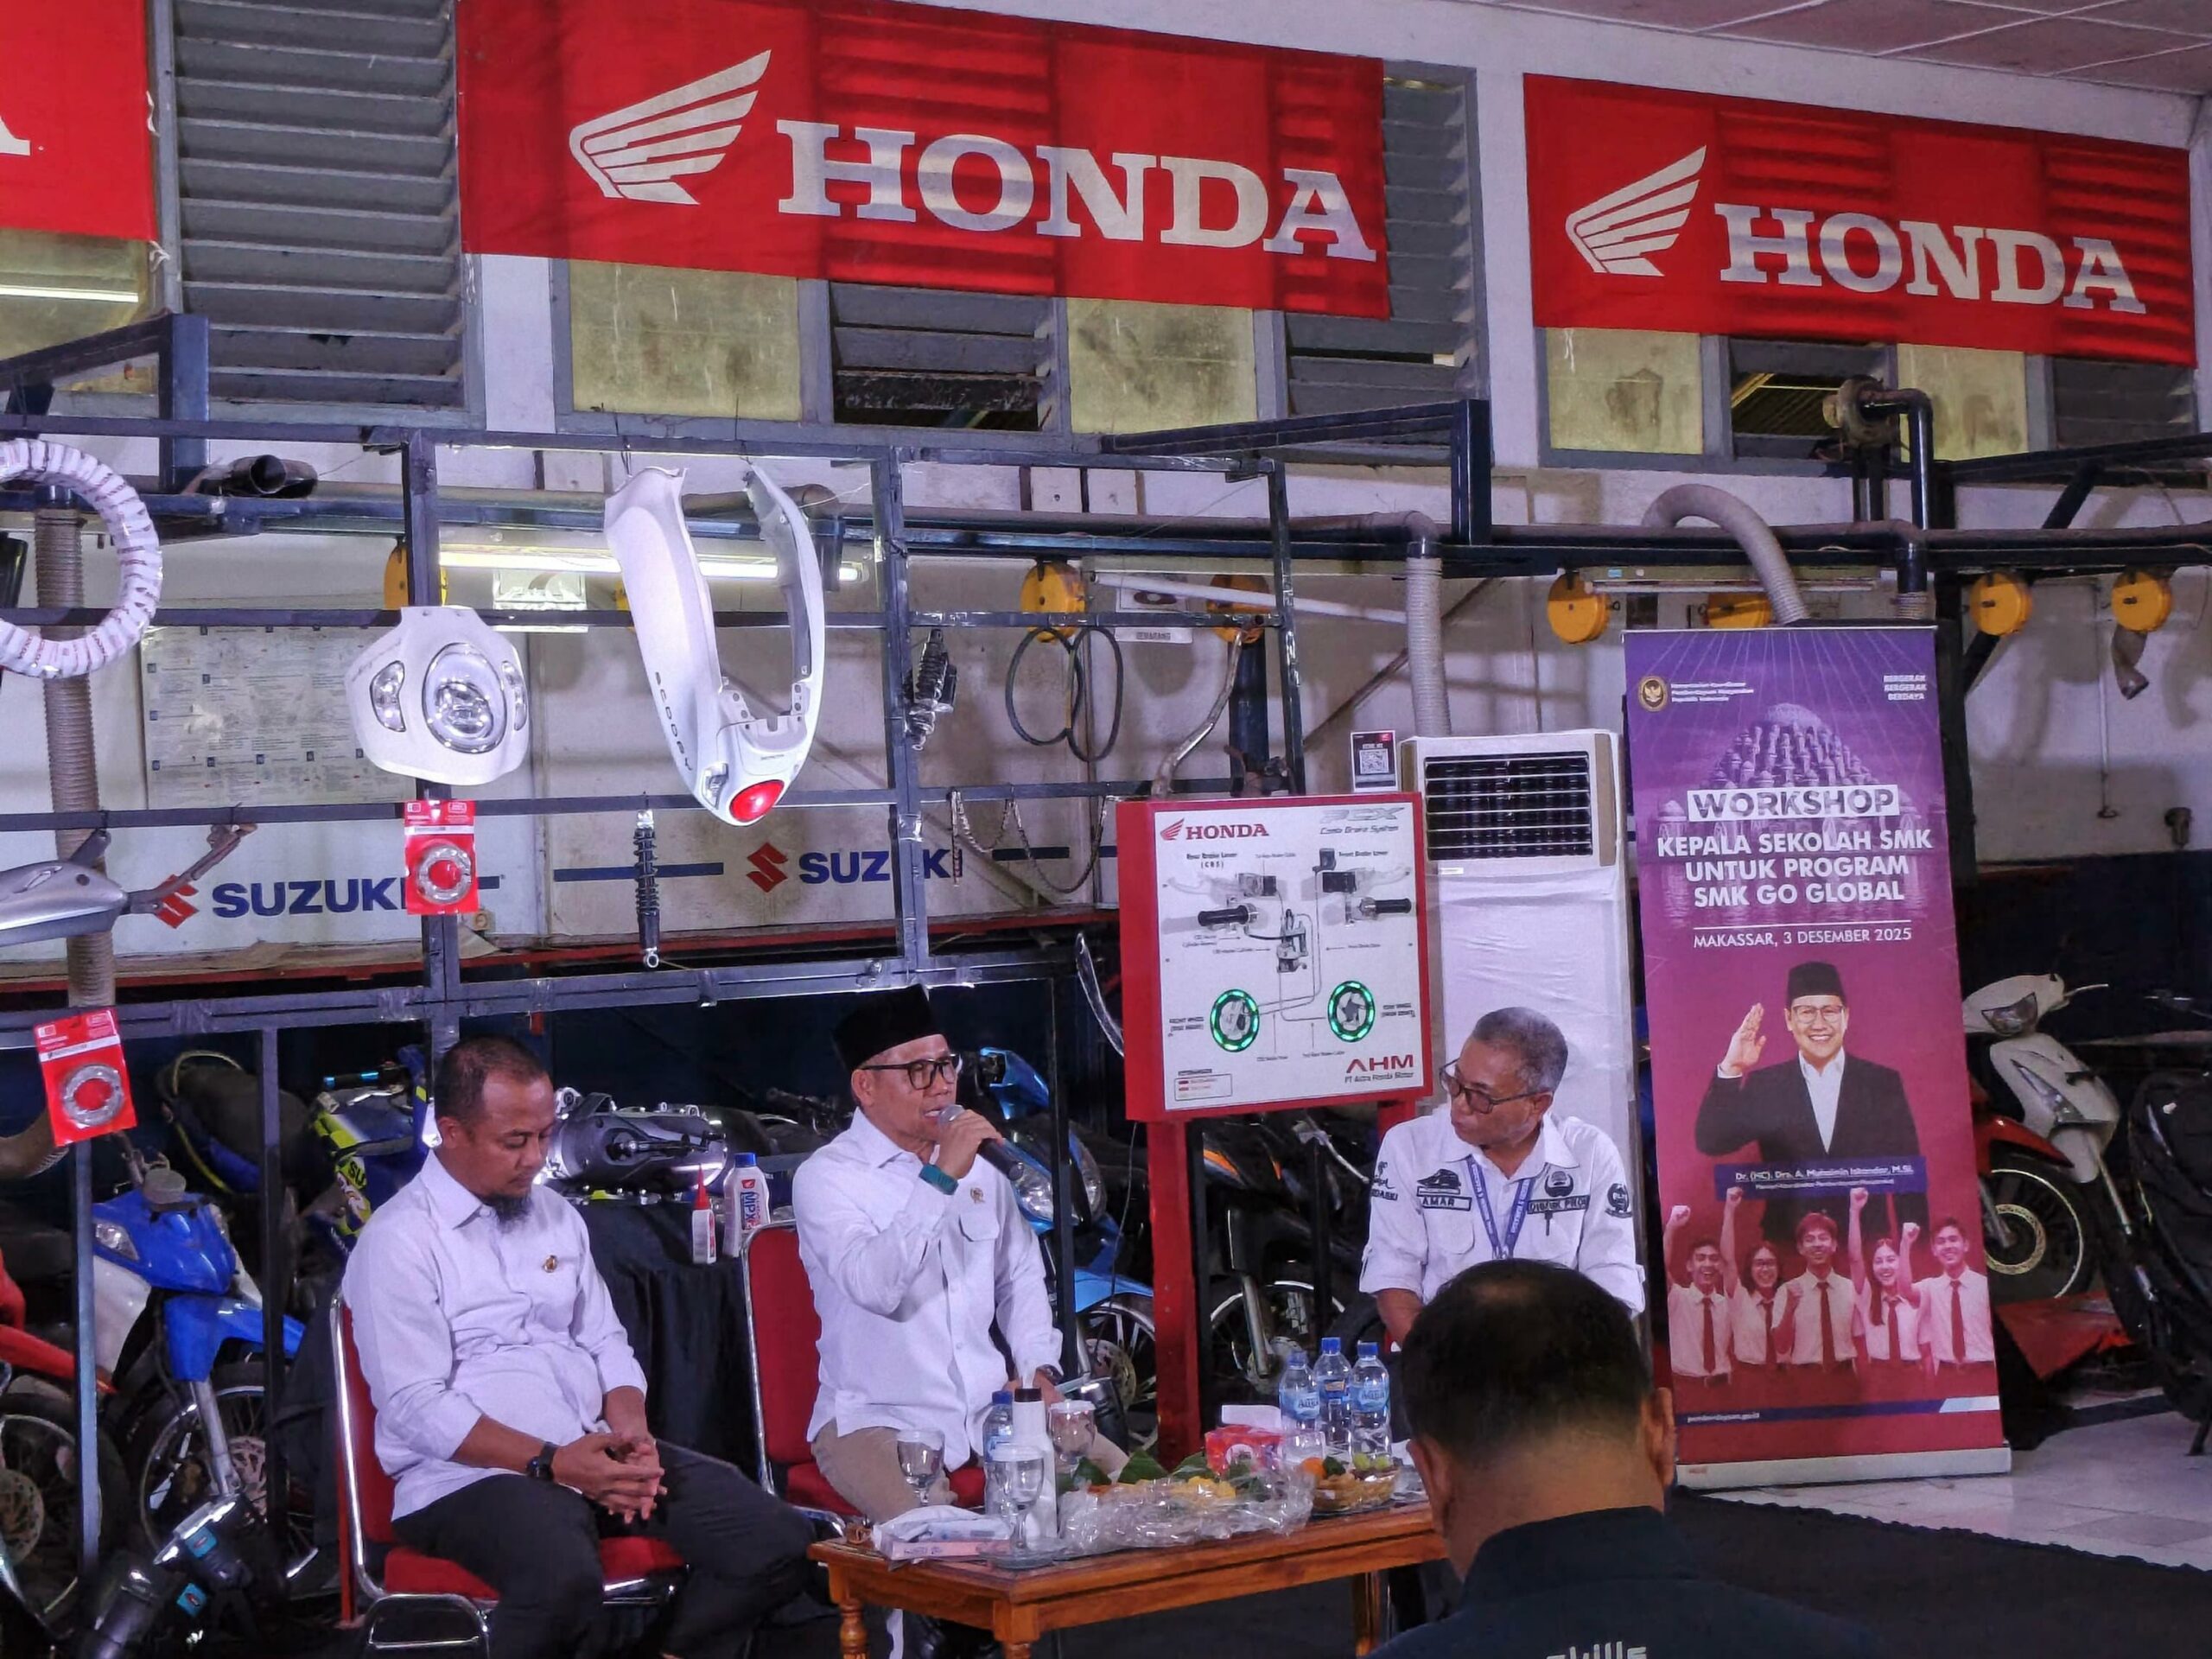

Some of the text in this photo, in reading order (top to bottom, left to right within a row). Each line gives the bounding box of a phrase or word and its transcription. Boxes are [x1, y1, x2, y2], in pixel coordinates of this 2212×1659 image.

[777, 119, 1376, 261] HONDA
[1713, 203, 2146, 315] HONDA
[1691, 788, 1895, 818] WORKSHOP
[1185, 823, 1269, 840] HONDA
[1657, 829, 1934, 857] KEPALA SEKOLAH SMK
[798, 849, 963, 884] SUZKI
[1685, 855, 1910, 882] UNTUK PROGRAM
[1694, 880, 1905, 907] SMK GO GLOBAL
[1694, 927, 1913, 949] MAKASSAR, 3 DESEMBER 2025
[1346, 1054, 1414, 1074] AHM
